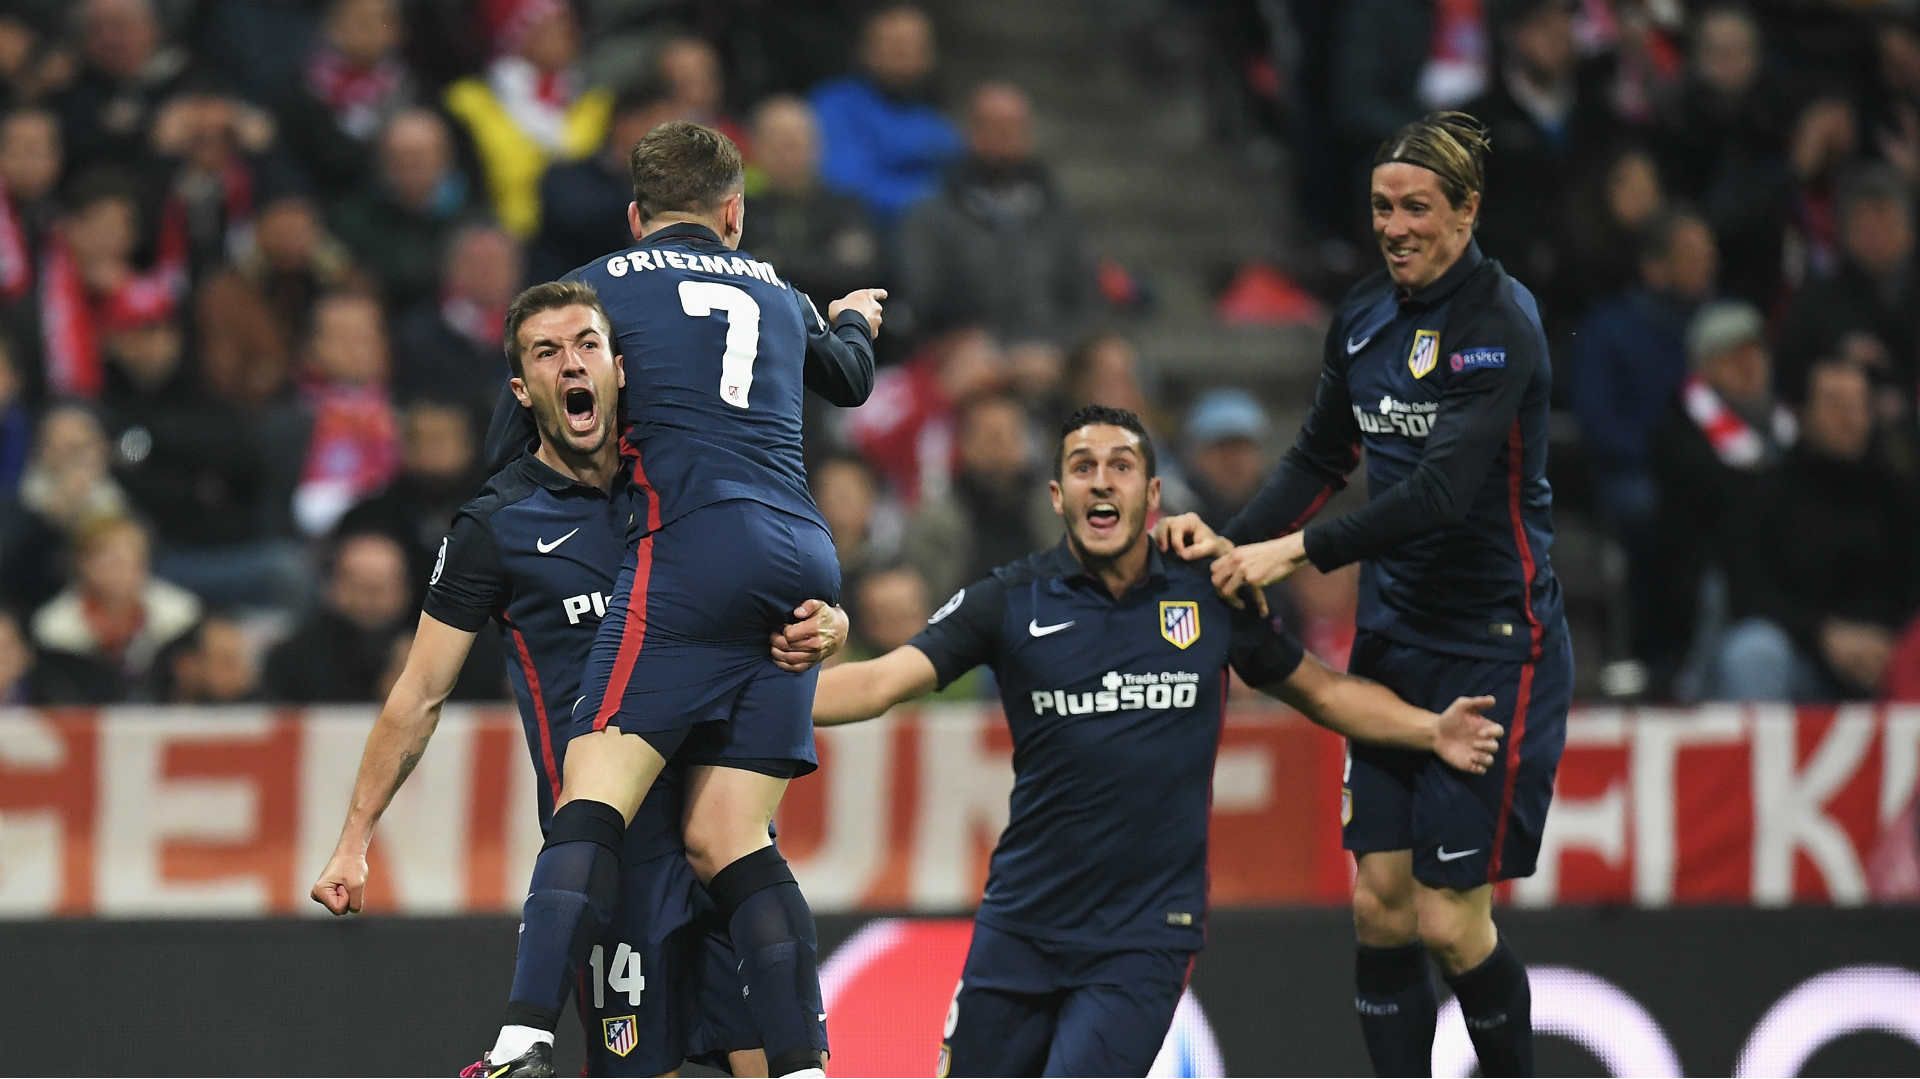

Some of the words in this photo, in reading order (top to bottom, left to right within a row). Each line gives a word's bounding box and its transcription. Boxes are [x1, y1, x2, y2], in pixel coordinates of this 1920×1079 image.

[678, 281, 760, 408] 7
[1463, 351, 1505, 365] RESPECT
[1123, 673, 1158, 685] Trade
[1160, 671, 1199, 684] Online
[1031, 682, 1197, 716] Plus500
[589, 942, 645, 1008] 14
